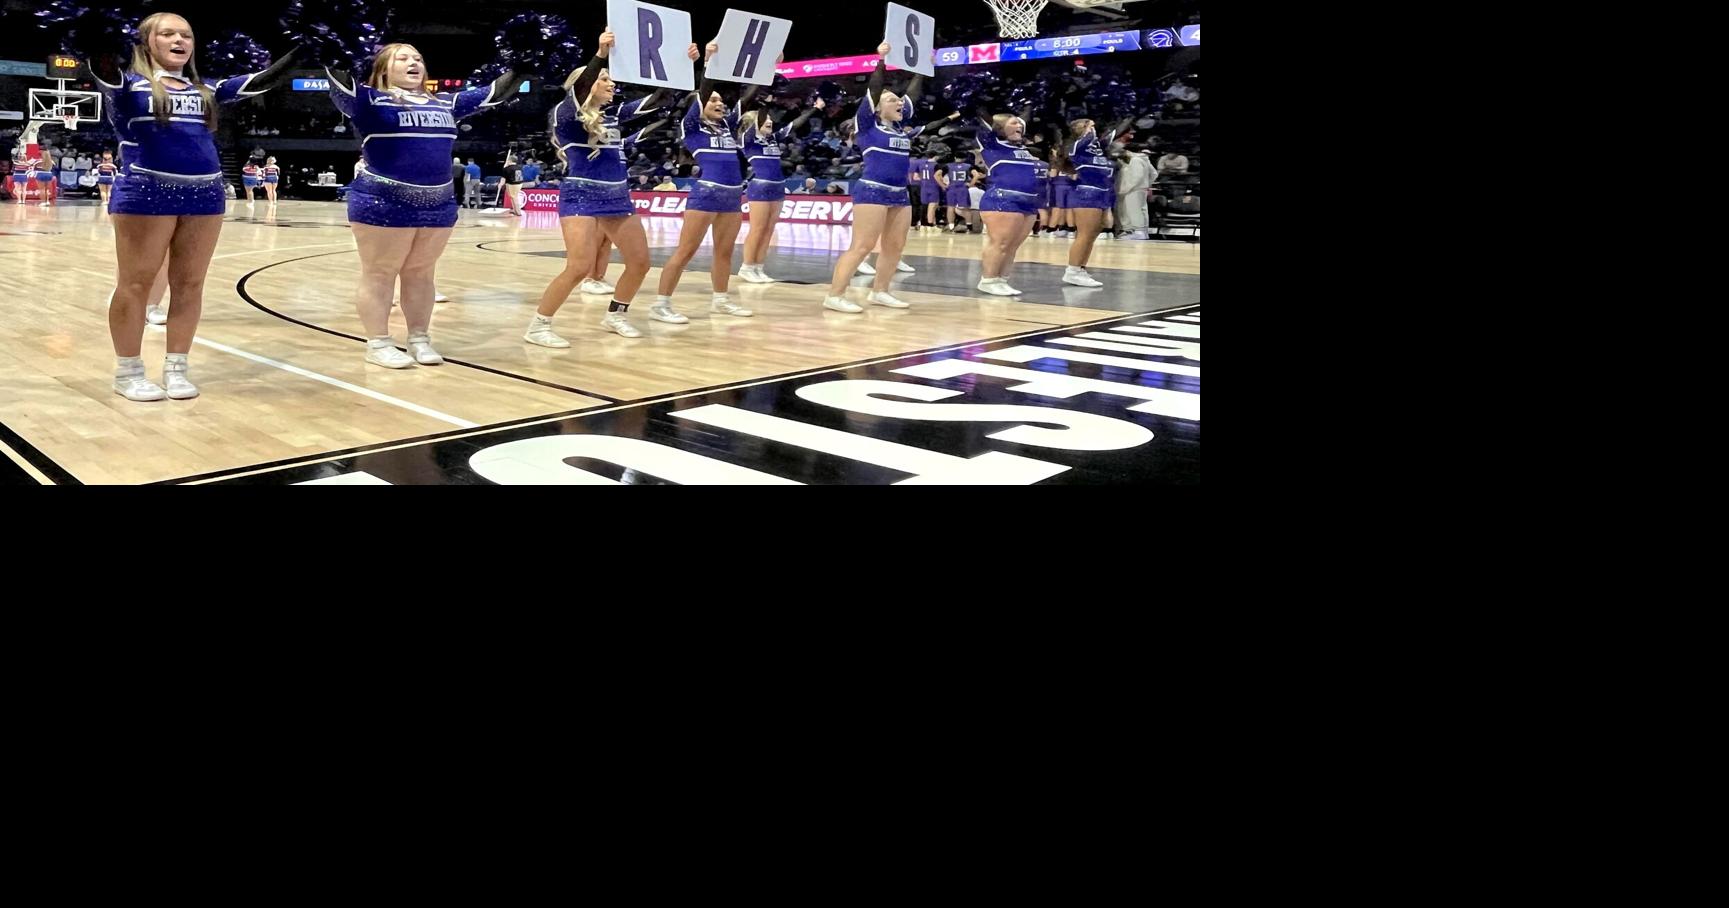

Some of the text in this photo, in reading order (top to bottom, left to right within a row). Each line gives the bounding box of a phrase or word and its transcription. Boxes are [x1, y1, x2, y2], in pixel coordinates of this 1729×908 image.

[637, 7, 668, 81] R
[732, 18, 771, 79] H
[904, 13, 920, 68] S
[942, 51, 959, 62] 59
[971, 45, 998, 61] M
[952, 170, 967, 181] 13
[635, 199, 650, 209] TO
